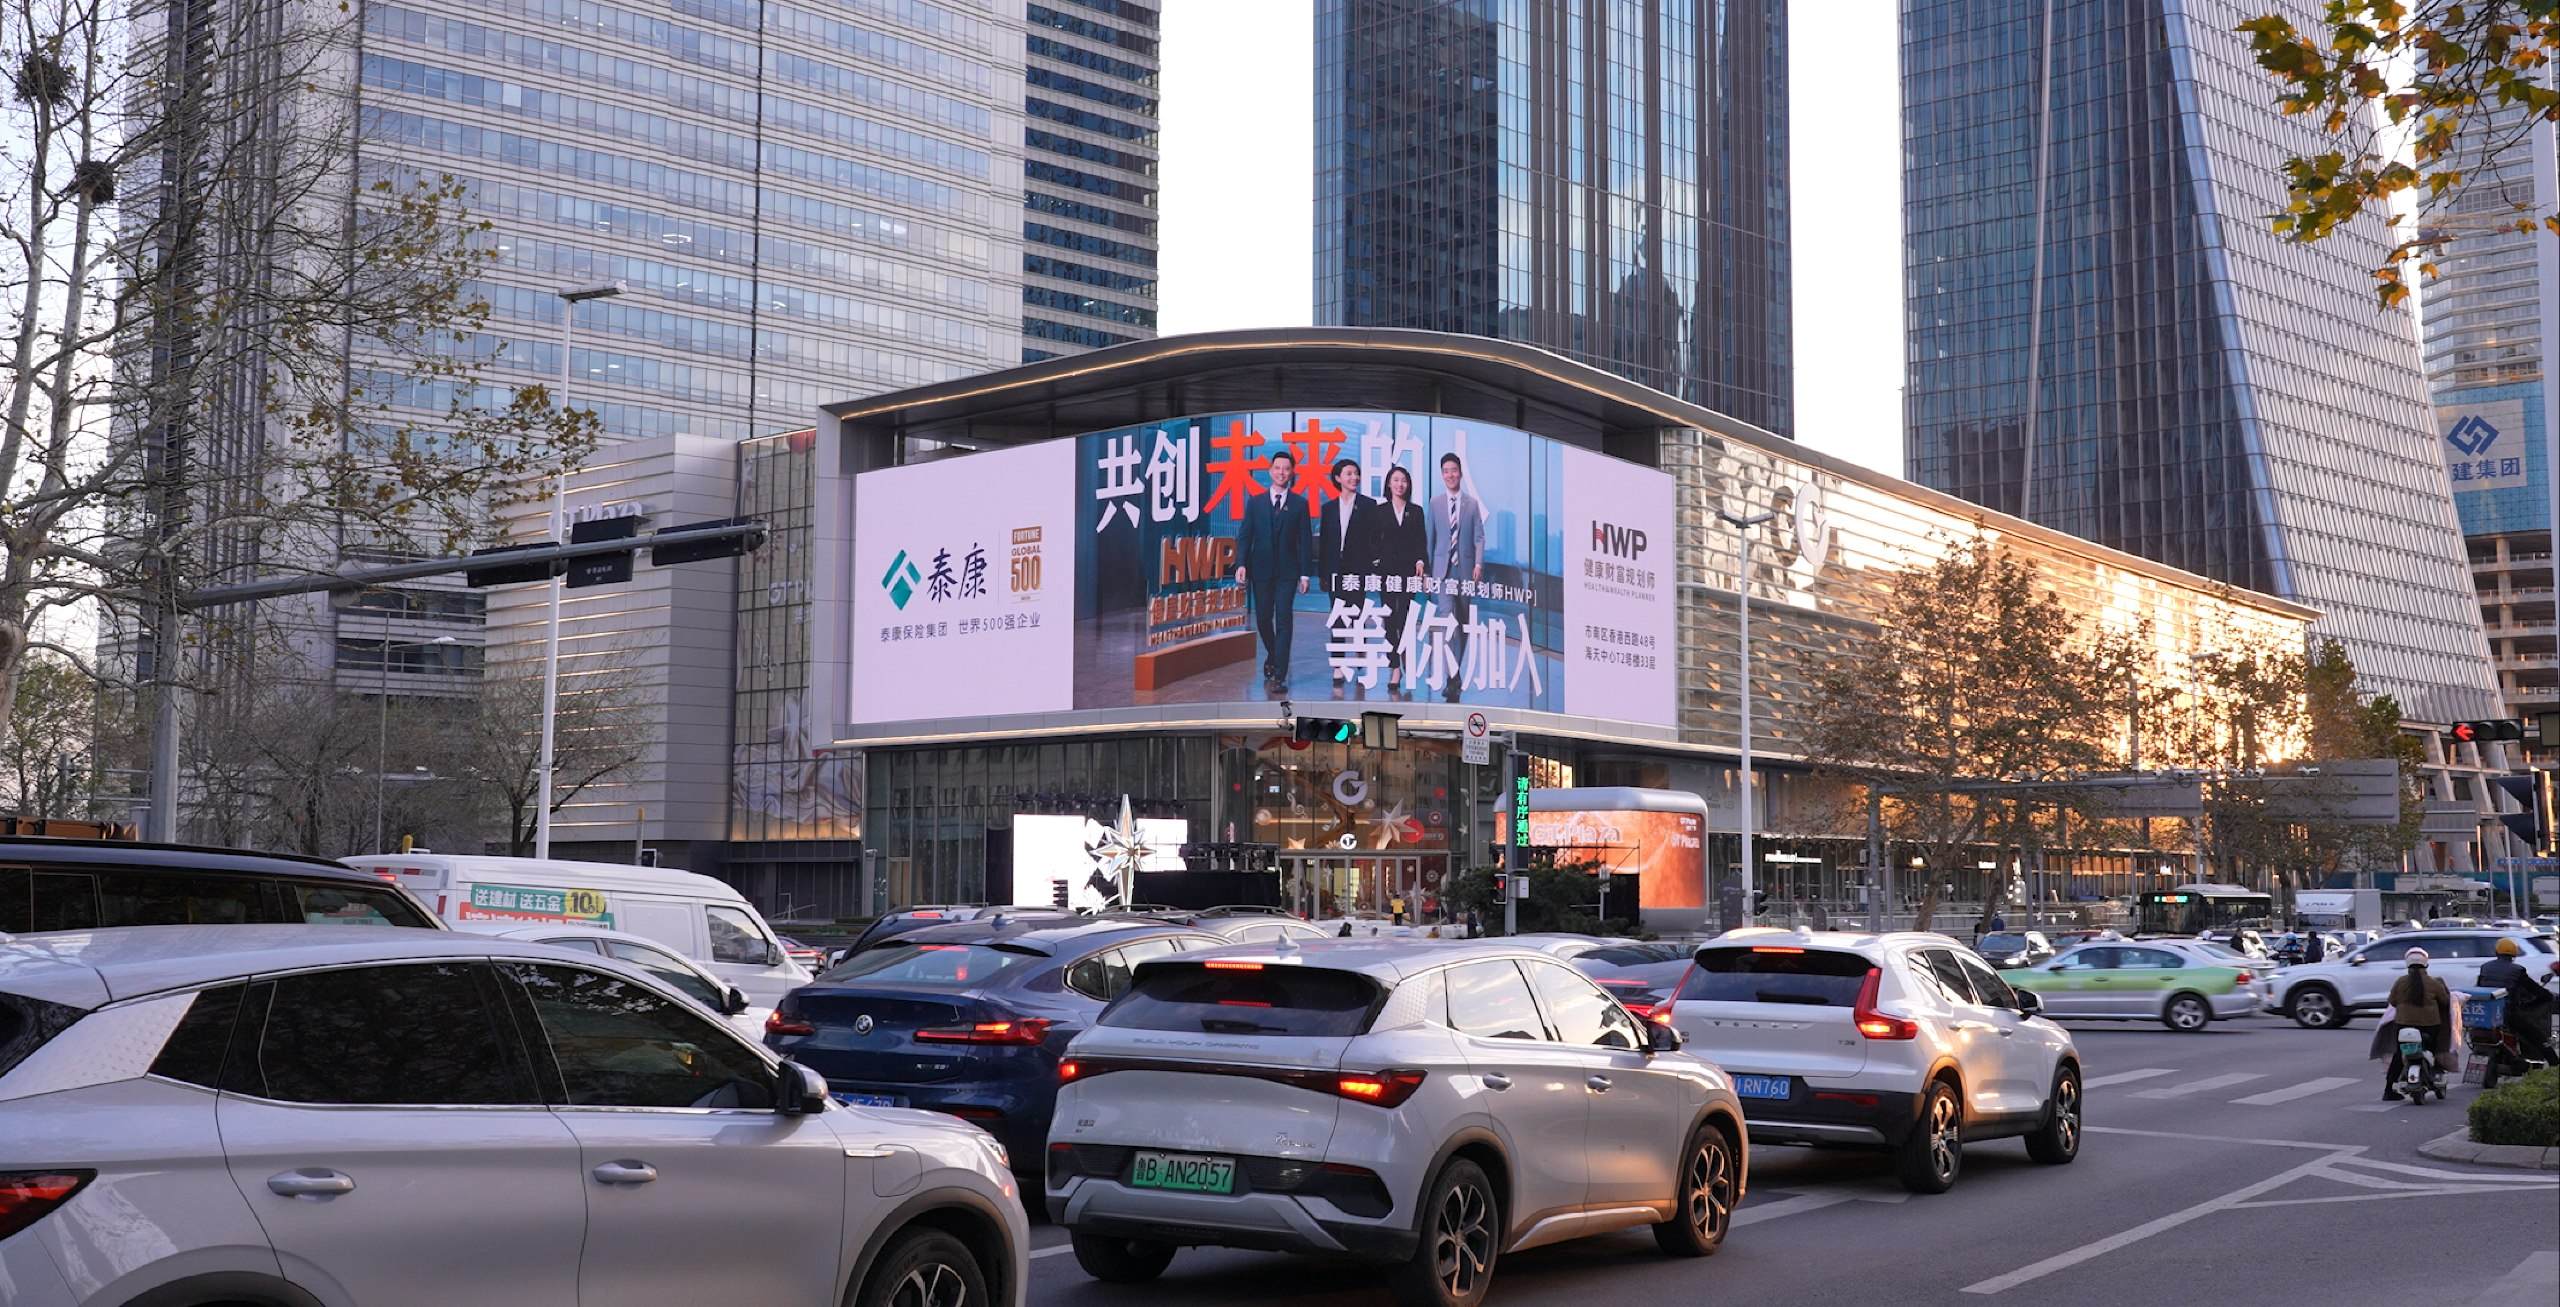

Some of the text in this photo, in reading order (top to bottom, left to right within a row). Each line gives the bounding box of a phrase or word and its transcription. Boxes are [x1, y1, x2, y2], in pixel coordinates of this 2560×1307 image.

[1011, 546, 1041, 557] GLOBAL
[1161, 536, 1237, 584] HWP
[1592, 520, 1647, 561] HWP
[927, 542, 988, 603] 泰康
[1011, 555, 1041, 592] 500
[1584, 558, 1656, 590] 健康财富规划师
[880, 611, 1041, 643] 泰康保险集团 世界500强企业
[1325, 598, 1543, 697] 等你加入
[1516, 776, 1529, 848] 请有序通过
[475, 888, 517, 909] 送建材
[519, 893, 562, 912] 送五金
